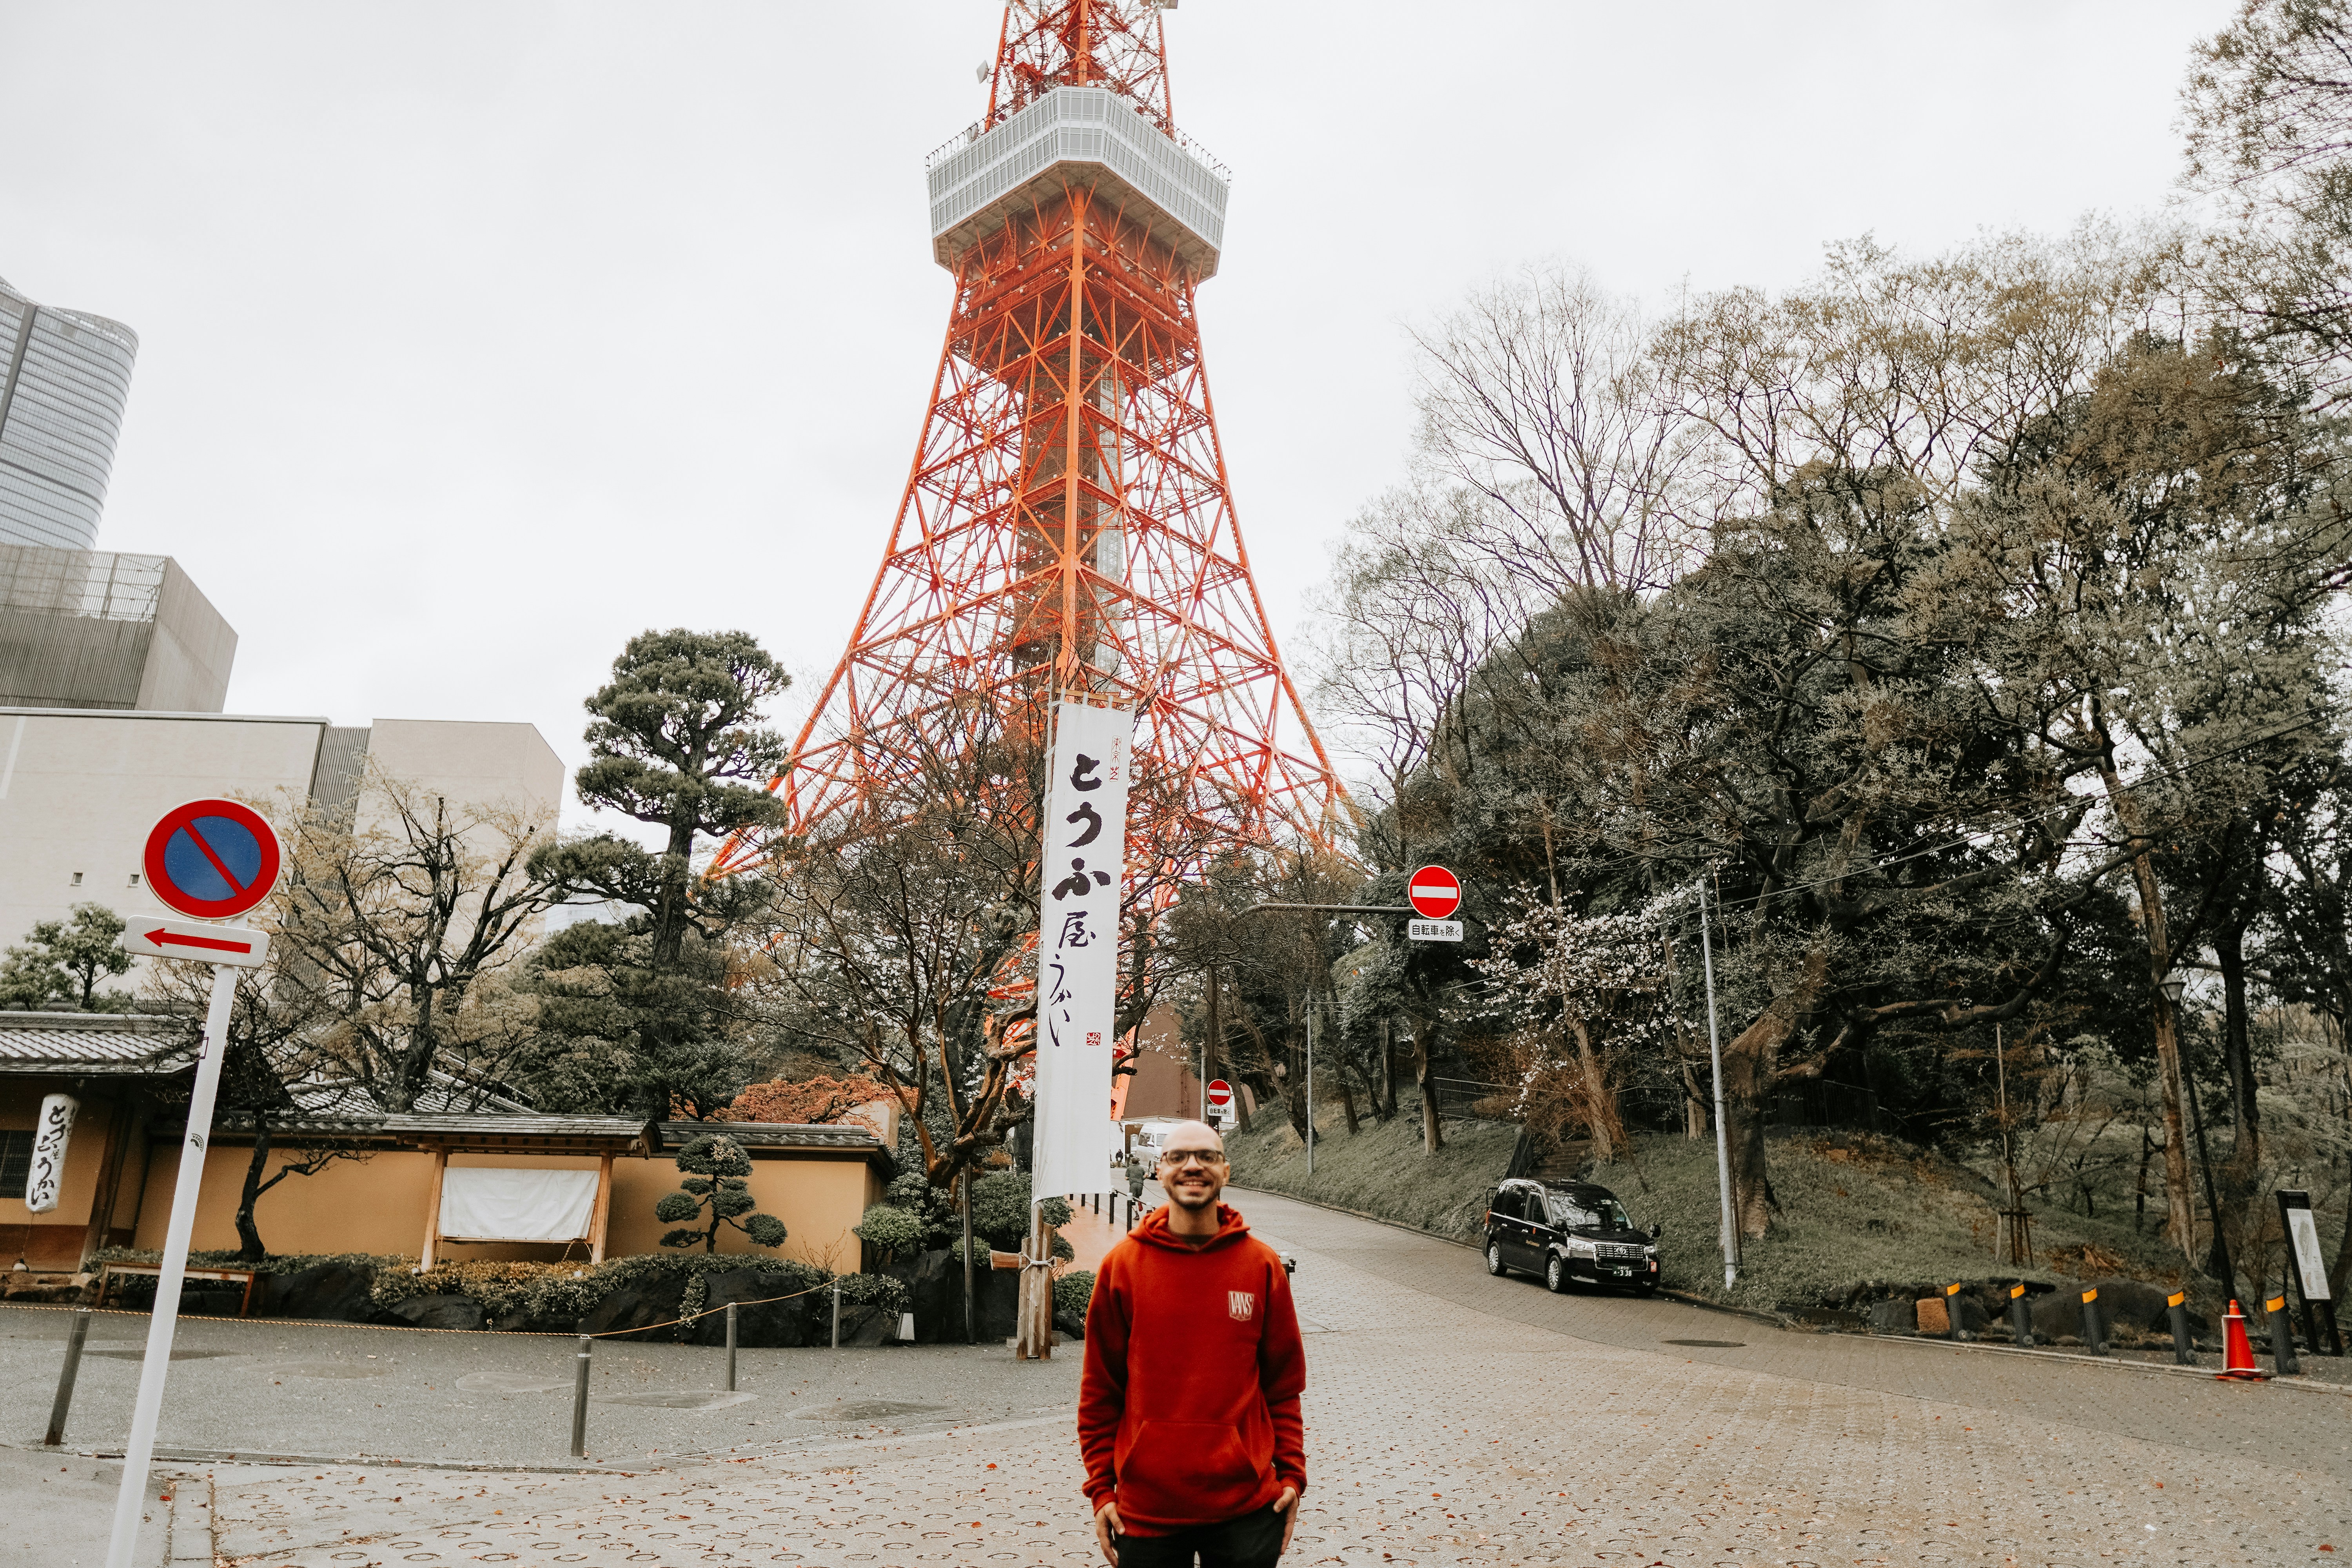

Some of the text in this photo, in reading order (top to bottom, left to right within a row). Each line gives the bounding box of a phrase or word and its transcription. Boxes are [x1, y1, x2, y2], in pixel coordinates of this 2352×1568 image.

[1412, 924, 1460, 936] 自転車を除く
[1230, 1292, 1252, 1315] VANS
